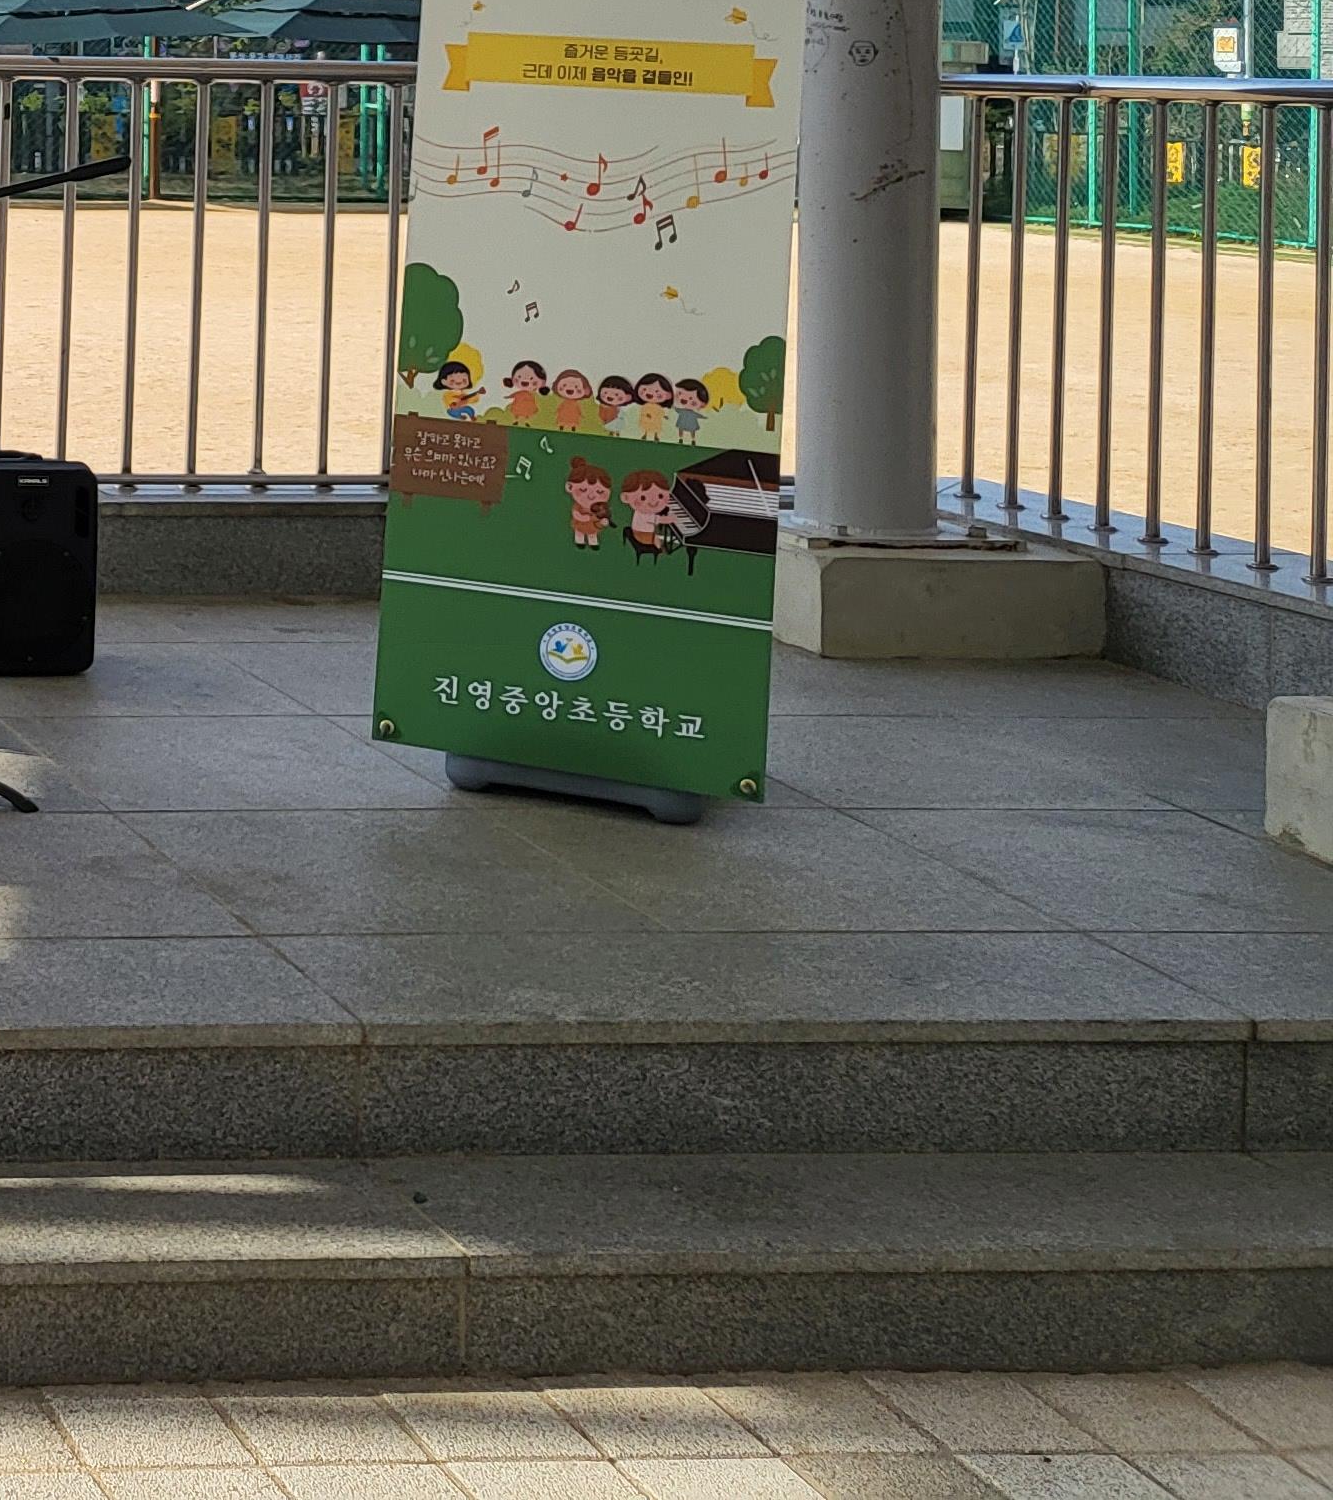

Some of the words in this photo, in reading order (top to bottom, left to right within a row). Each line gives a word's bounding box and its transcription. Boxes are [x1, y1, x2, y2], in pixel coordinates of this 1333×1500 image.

[564, 43, 609, 61] 즐거운
[614, 46, 664, 64] 등굣길,
[522, 63, 553, 80] 근데
[557, 64, 587, 81] 이제
[591, 66, 637, 84] 음악을
[642, 68, 693, 86] 곁들인!
[432, 675, 706, 740] 진영중앙초등학교
